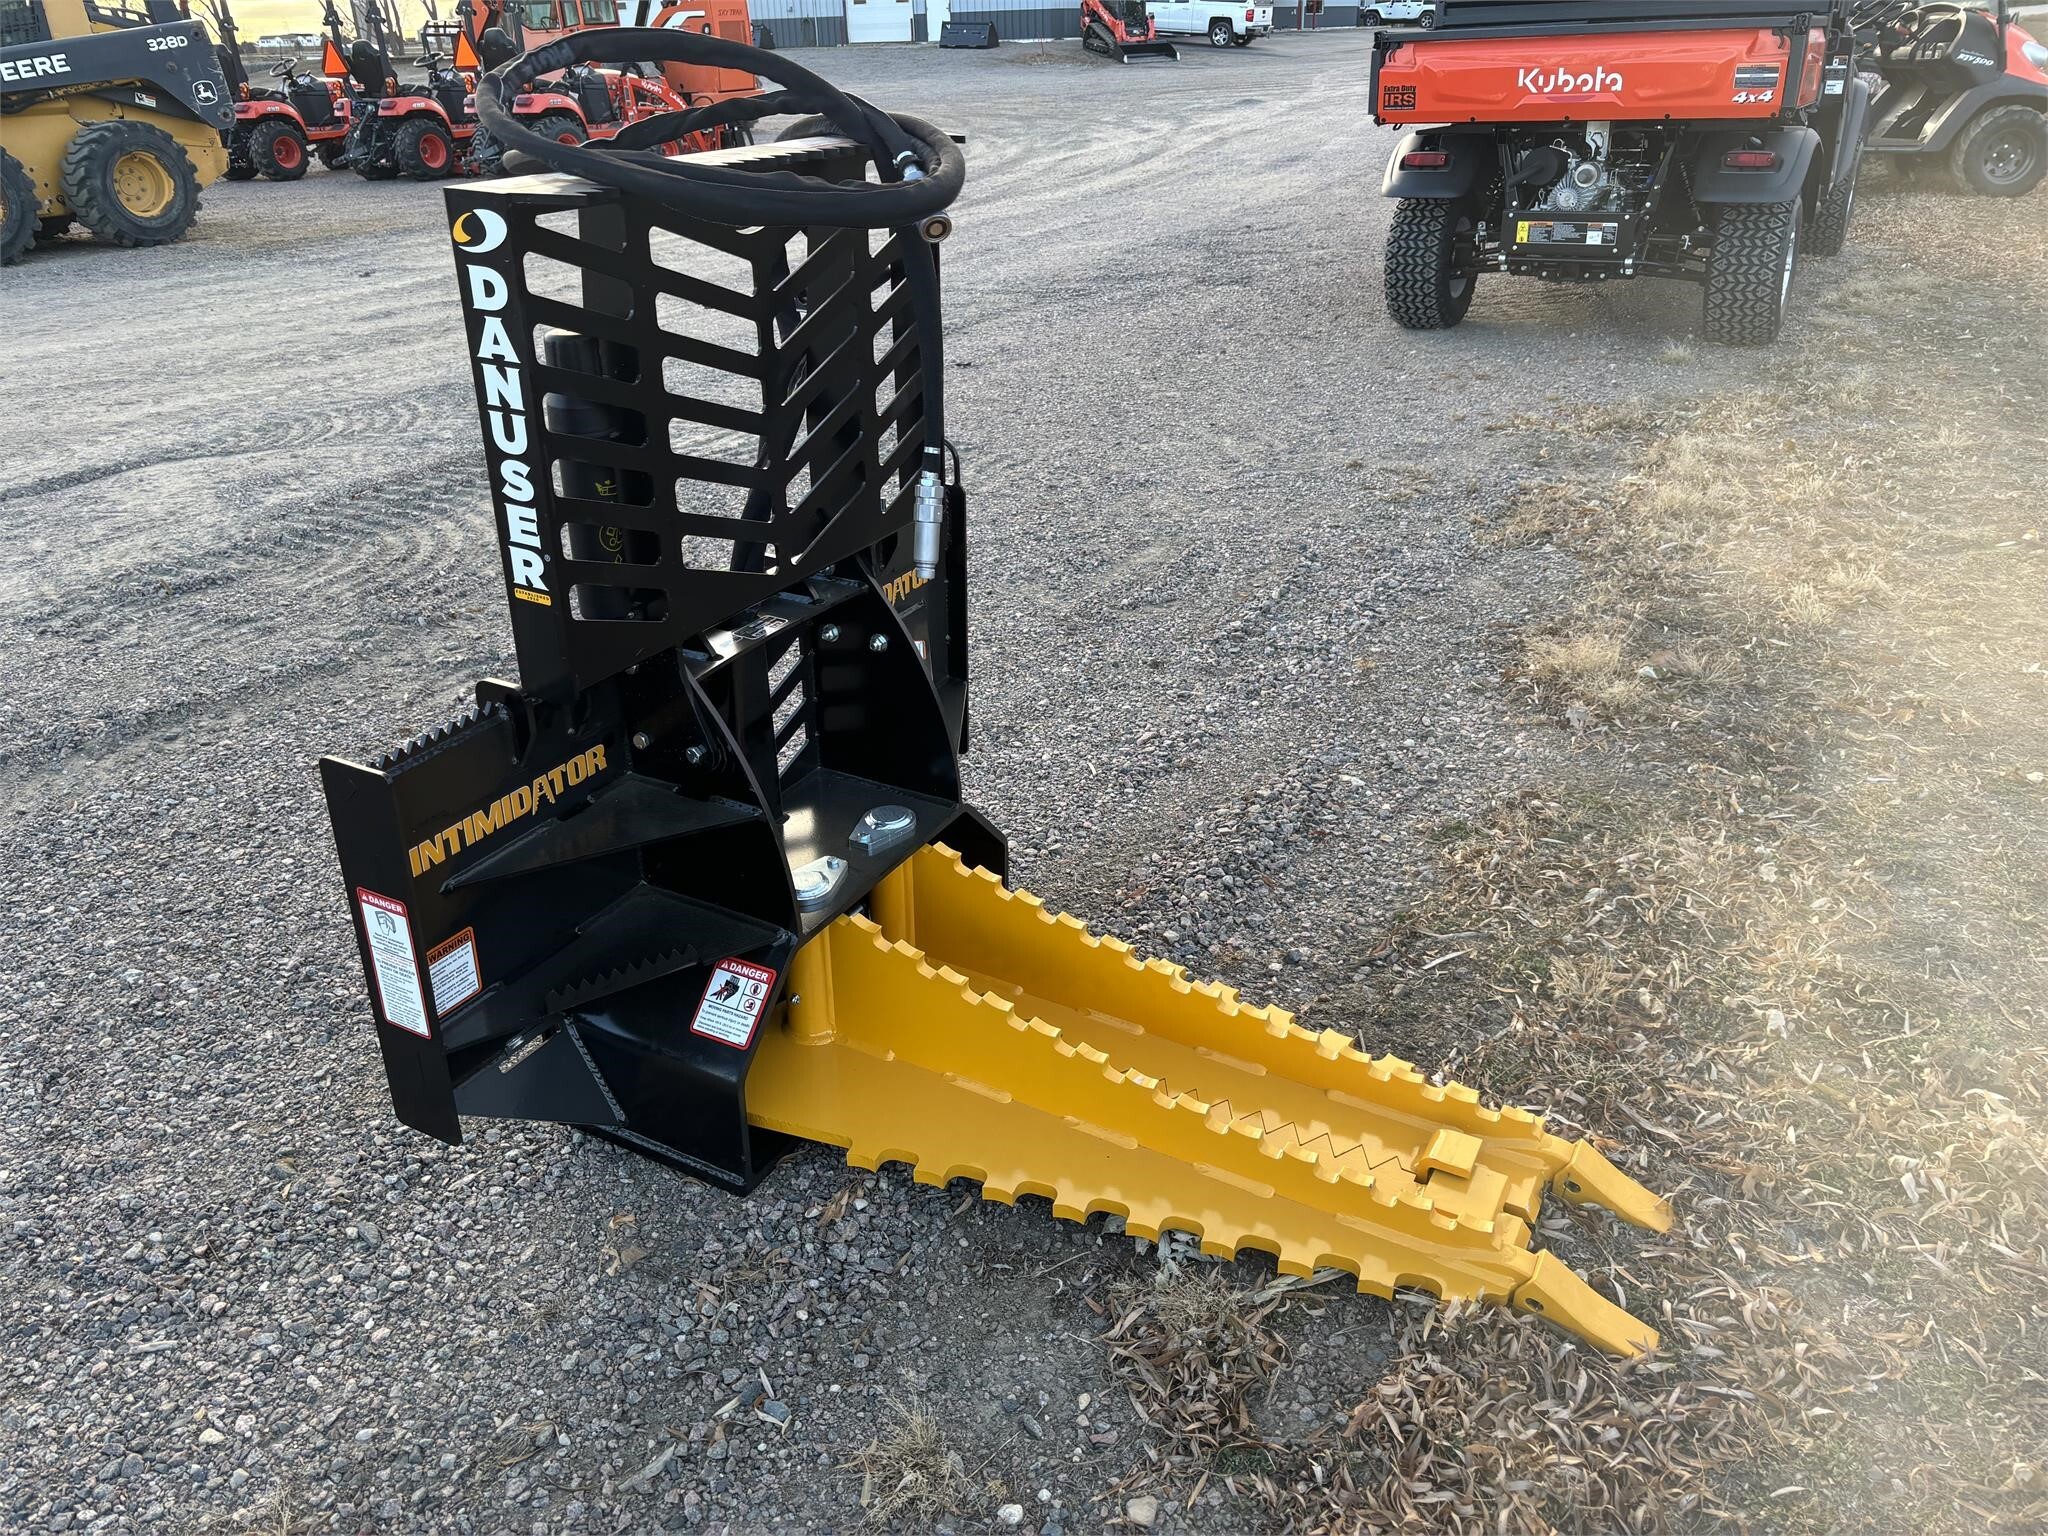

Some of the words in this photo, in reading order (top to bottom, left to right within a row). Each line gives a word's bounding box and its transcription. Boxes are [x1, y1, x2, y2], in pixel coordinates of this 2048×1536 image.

[146, 35, 188, 51] 328D
[1518, 66, 1623, 93] Kubota
[1384, 93, 1415, 106] IRS
[1731, 90, 1774, 104] 4x4
[466, 264, 550, 592] DANUSER
[408, 743, 608, 878] INTIMIDATOR
[368, 895, 403, 914] DANGER
[428, 933, 471, 964] WARNING
[729, 962, 769, 981] DANGER
